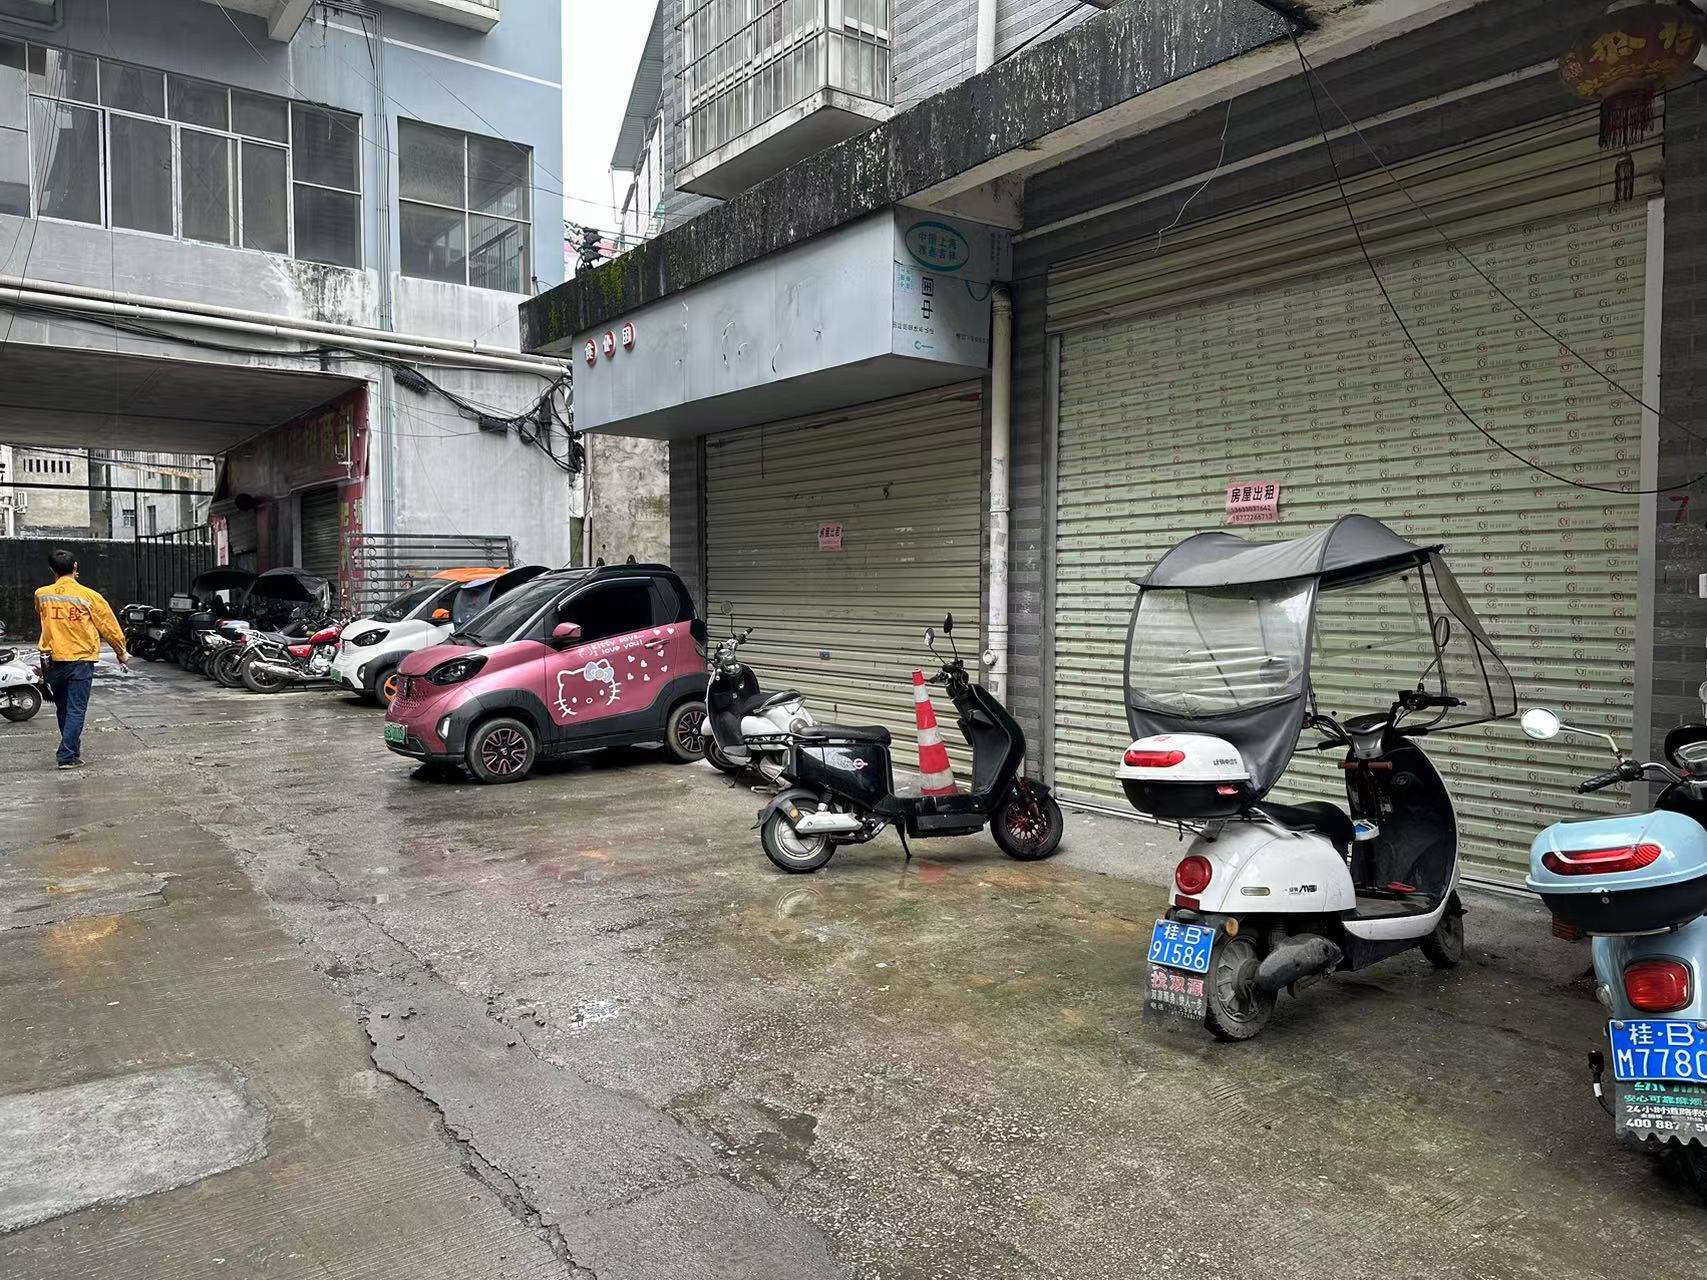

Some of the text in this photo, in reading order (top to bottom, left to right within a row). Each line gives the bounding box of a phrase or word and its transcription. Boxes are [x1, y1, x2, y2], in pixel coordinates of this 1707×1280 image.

[1231, 484, 1275, 503] 房屋出租
[602, 646, 620, 655] love
[1151, 940, 1206, 970] 91586
[1625, 1118, 1652, 1129] 400
